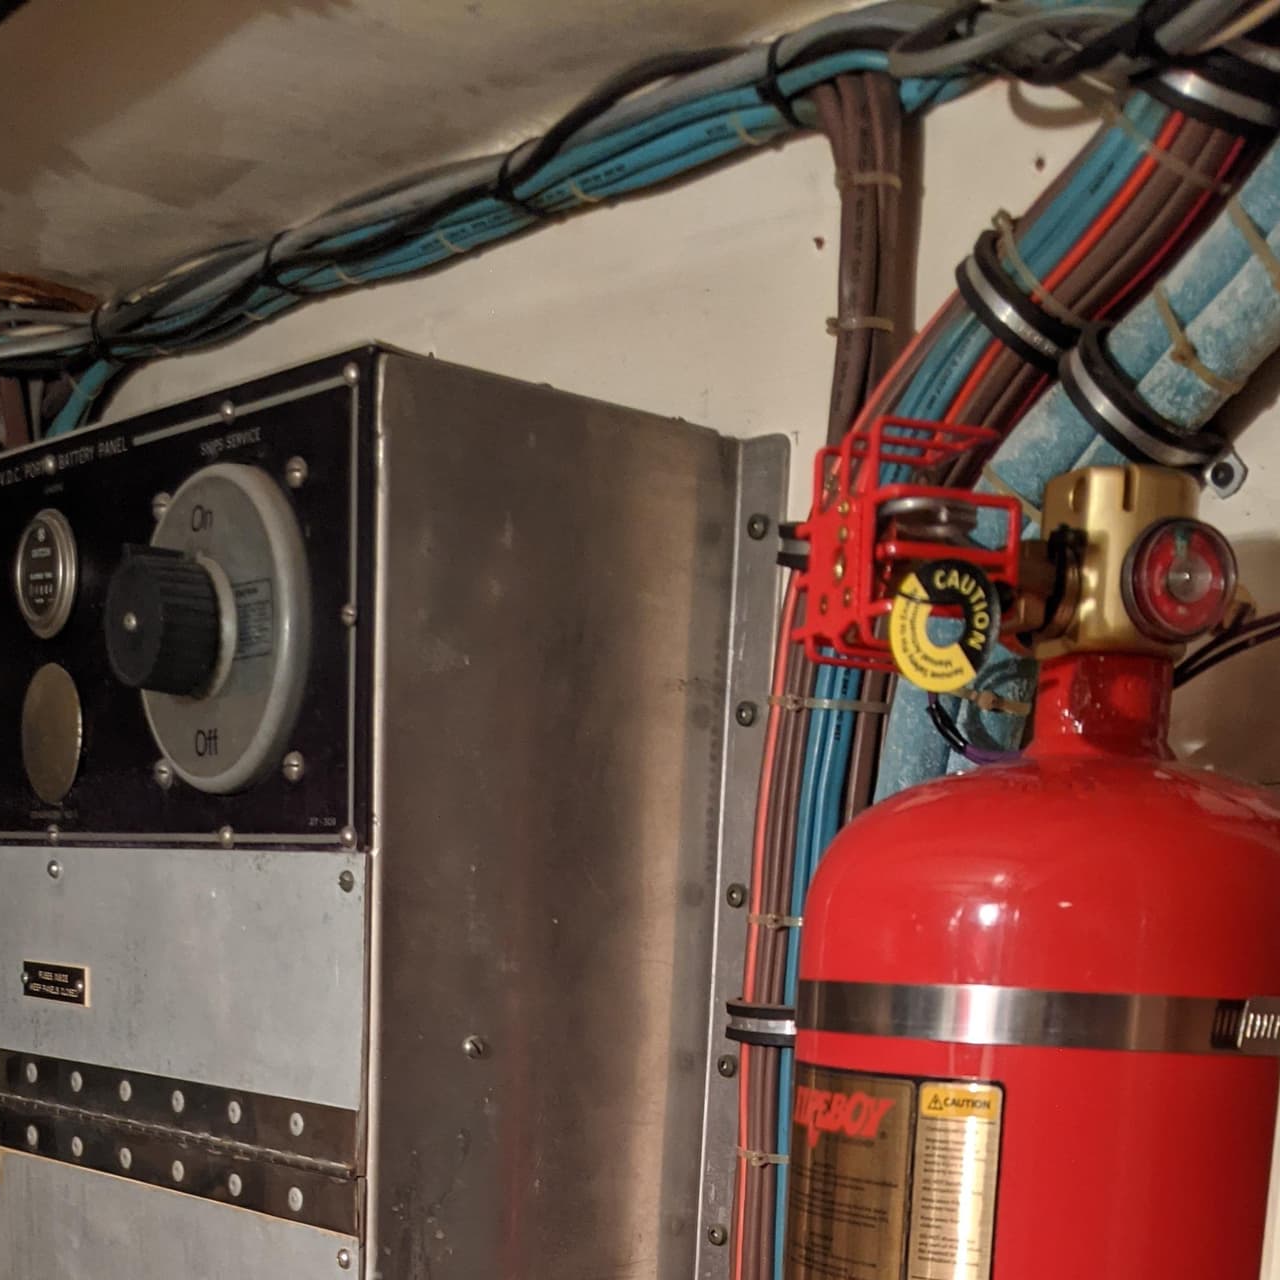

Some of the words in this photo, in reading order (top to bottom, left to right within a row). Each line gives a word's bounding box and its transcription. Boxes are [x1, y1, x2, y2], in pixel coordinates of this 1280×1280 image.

[57, 446, 95, 470] BATTERY
[97, 436, 129, 457] PANEL
[192, 504, 214, 532] On
[934, 569, 990, 651] CAUTION
[195, 728, 218, 757] Off
[943, 1097, 991, 1110] CAUTION
